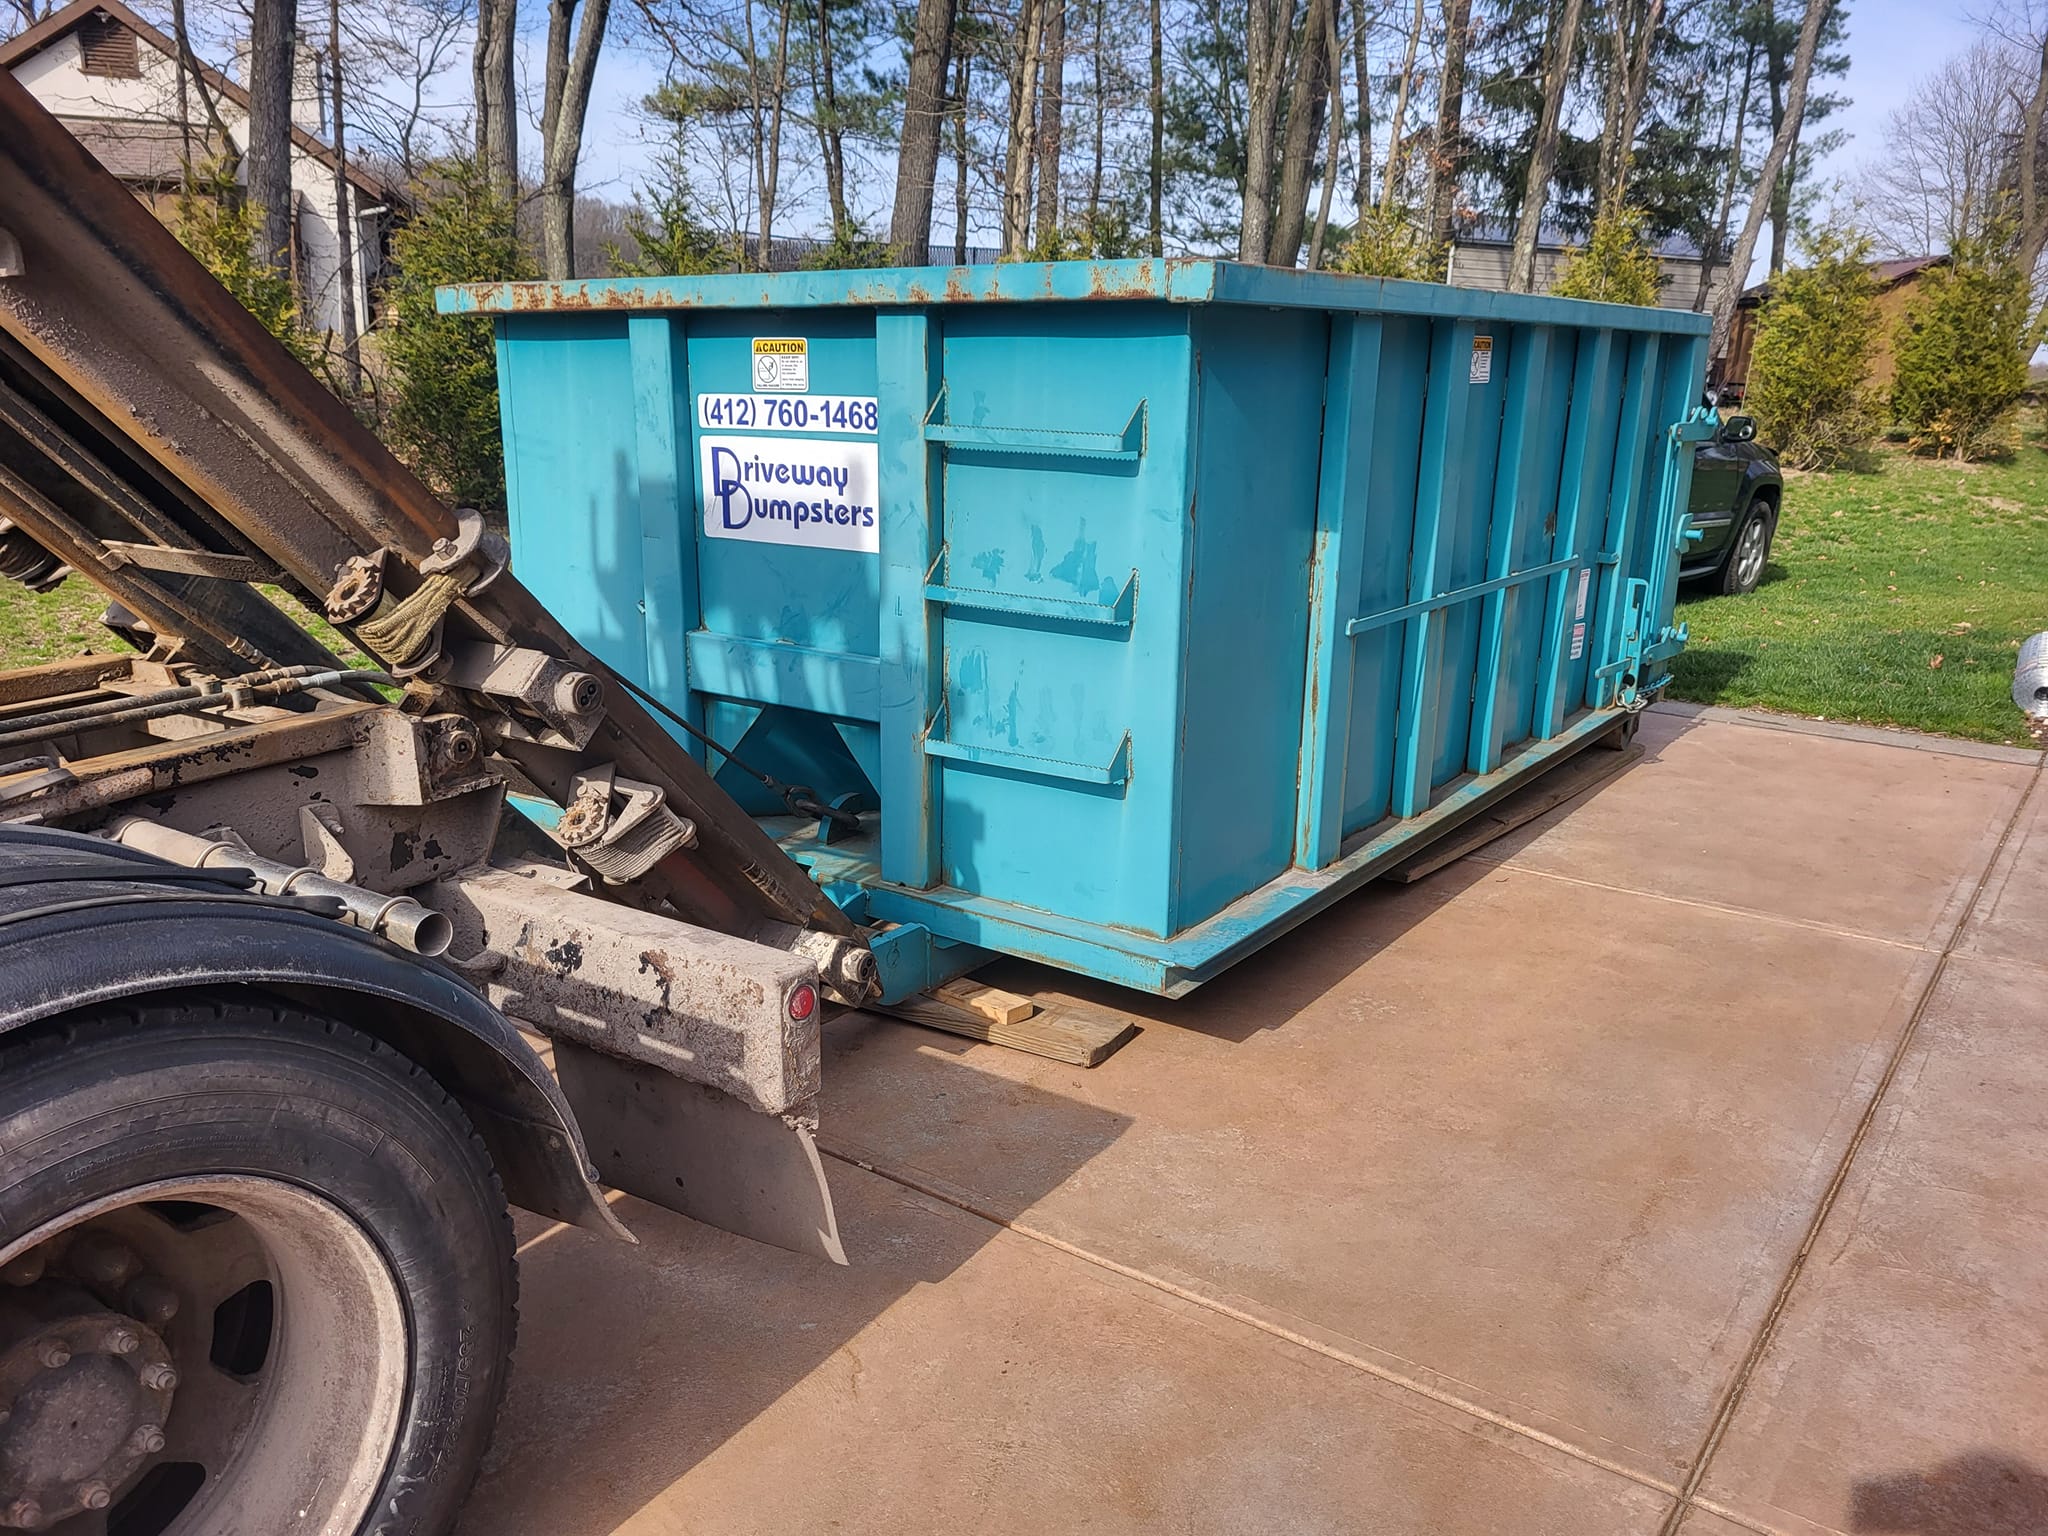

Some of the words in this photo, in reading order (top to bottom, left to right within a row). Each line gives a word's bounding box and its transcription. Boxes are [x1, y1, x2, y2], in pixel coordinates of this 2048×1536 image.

[762, 343, 804, 352] CAUTION
[704, 397, 756, 427] (412)
[764, 399, 878, 430] 760-1468
[711, 446, 848, 496] Driveway
[721, 479, 874, 529] Dumpsters
